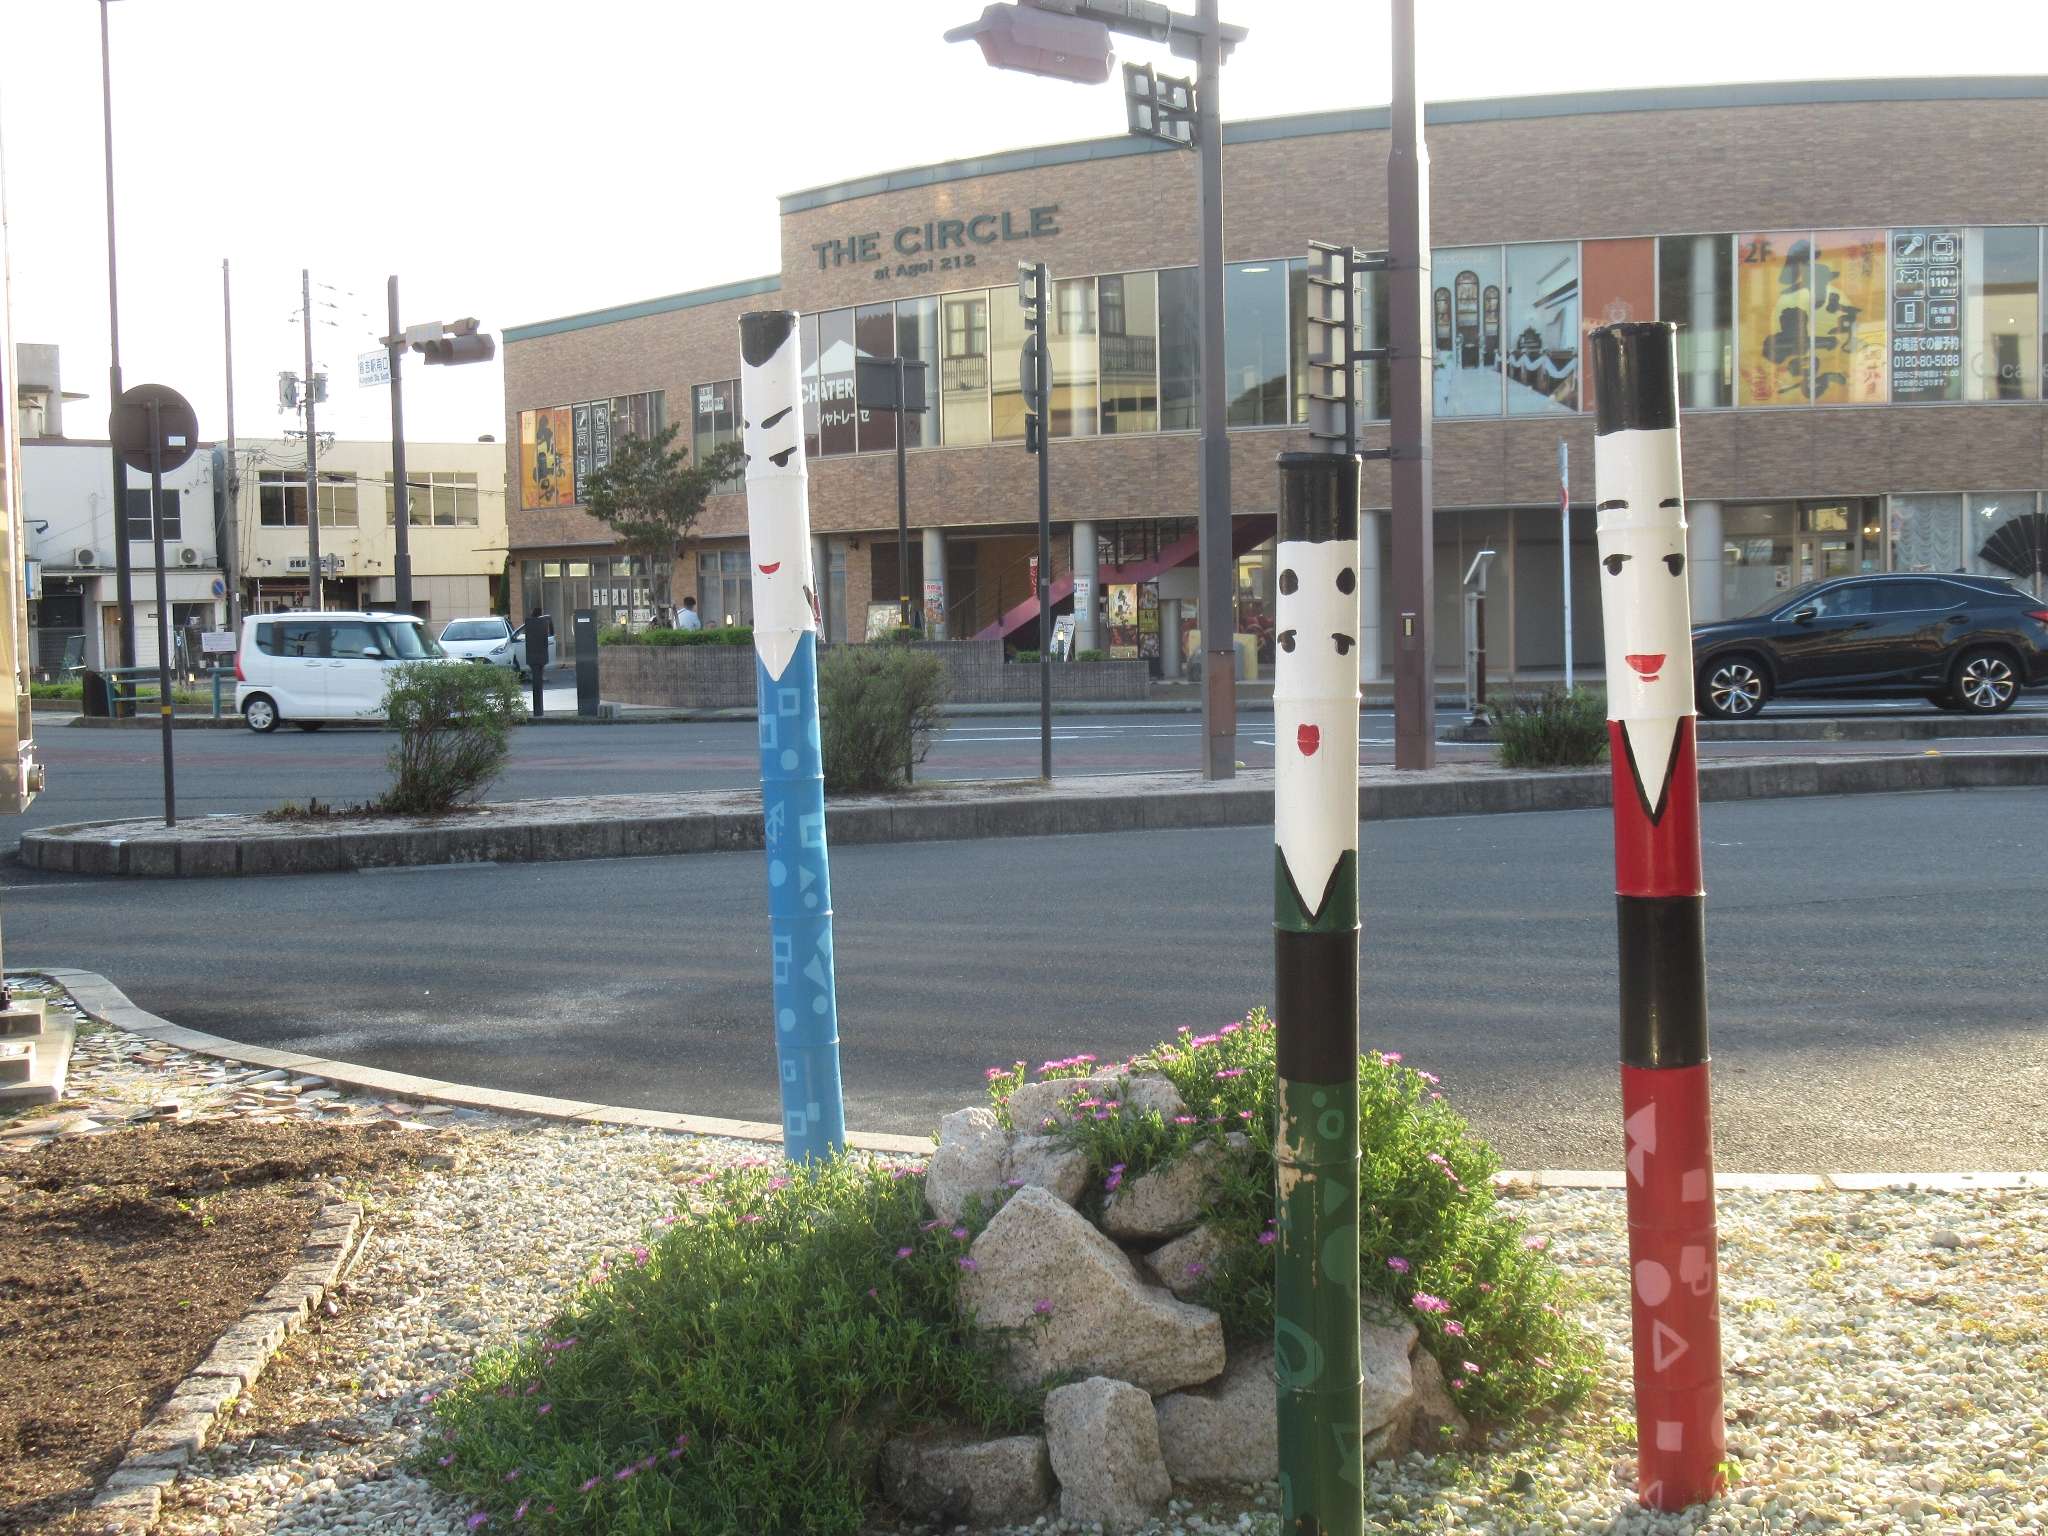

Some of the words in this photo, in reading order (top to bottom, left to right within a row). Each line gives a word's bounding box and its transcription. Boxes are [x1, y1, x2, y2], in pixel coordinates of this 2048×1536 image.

[812, 232, 881, 270] THE
[894, 205, 1059, 256] CIRCLE
[1743, 239, 1773, 263] 2F
[874, 265, 890, 280] at
[940, 254, 977, 270] 212
[1930, 277, 1949, 287] 110
[801, 375, 856, 403] CHÂTER
